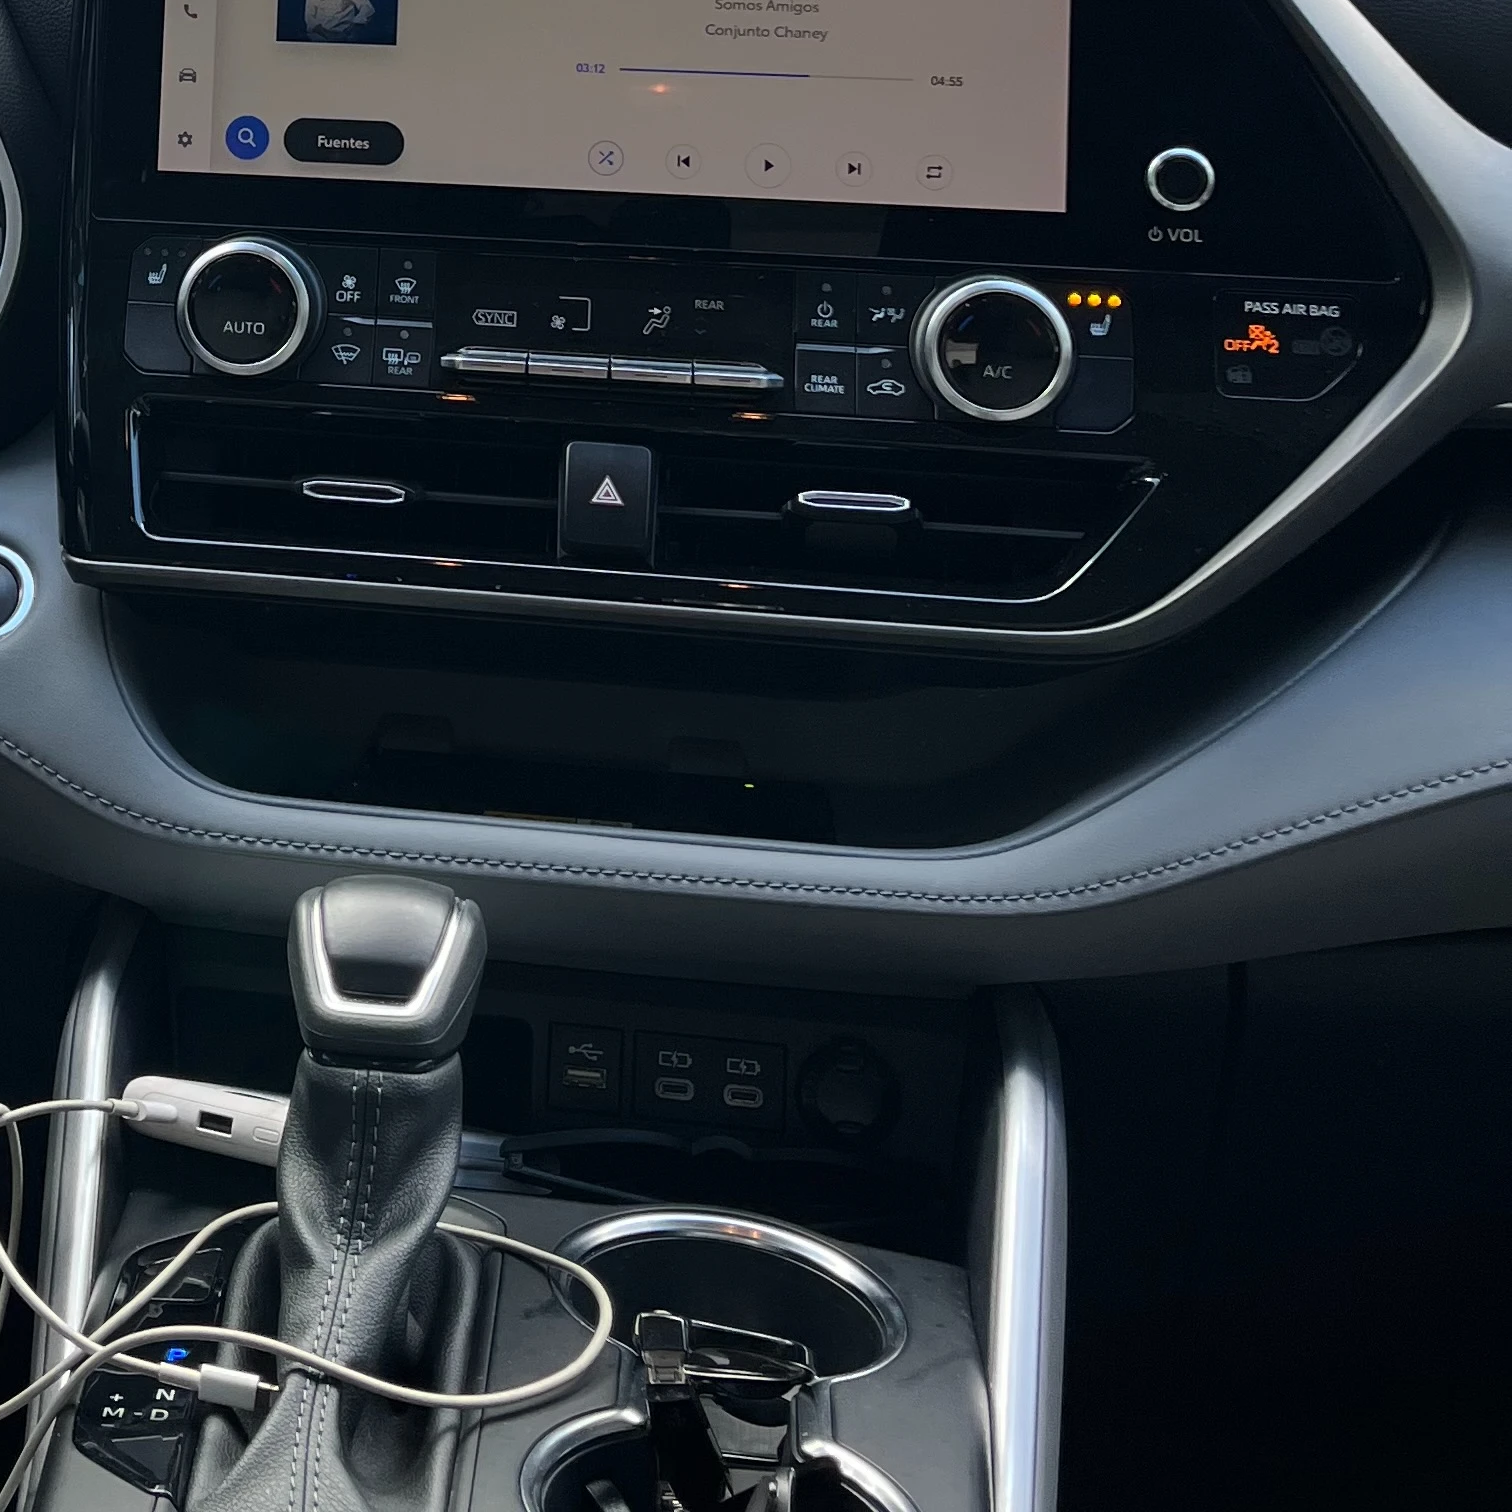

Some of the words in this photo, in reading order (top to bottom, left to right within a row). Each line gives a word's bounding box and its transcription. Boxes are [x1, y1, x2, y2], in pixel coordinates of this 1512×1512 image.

[715, 0, 762, 12] Somos
[766, 0, 820, 16] Amigos
[705, 24, 770, 41] Conjunto
[774, 26, 829, 42] Chaney
[576, 63, 606, 74] 03:12
[931, 75, 963, 87] 04:55
[317, 136, 370, 150] Fuentes
[1167, 228, 1203, 243] VOL
[335, 289, 362, 304] OFF
[389, 294, 420, 305] FRONT
[694, 299, 725, 311] REAR
[1244, 300, 1280, 314] PASS
[1282, 303, 1308, 316] AIR
[1309, 304, 1341, 317] BAG
[478, 311, 512, 326] SYNC
[810, 319, 839, 329] REAR
[223, 320, 266, 336] AUTO
[1223, 339, 1251, 352] OFF
[387, 365, 413, 376] REAR
[982, 364, 1013, 381] A/C
[810, 374, 839, 385] REAR
[803, 384, 846, 395] CLIMATE
[167, 1347, 189, 1362] P
[155, 1388, 176, 1402] N
[101, 1406, 126, 1419] M
[149, 1408, 170, 1422] D
